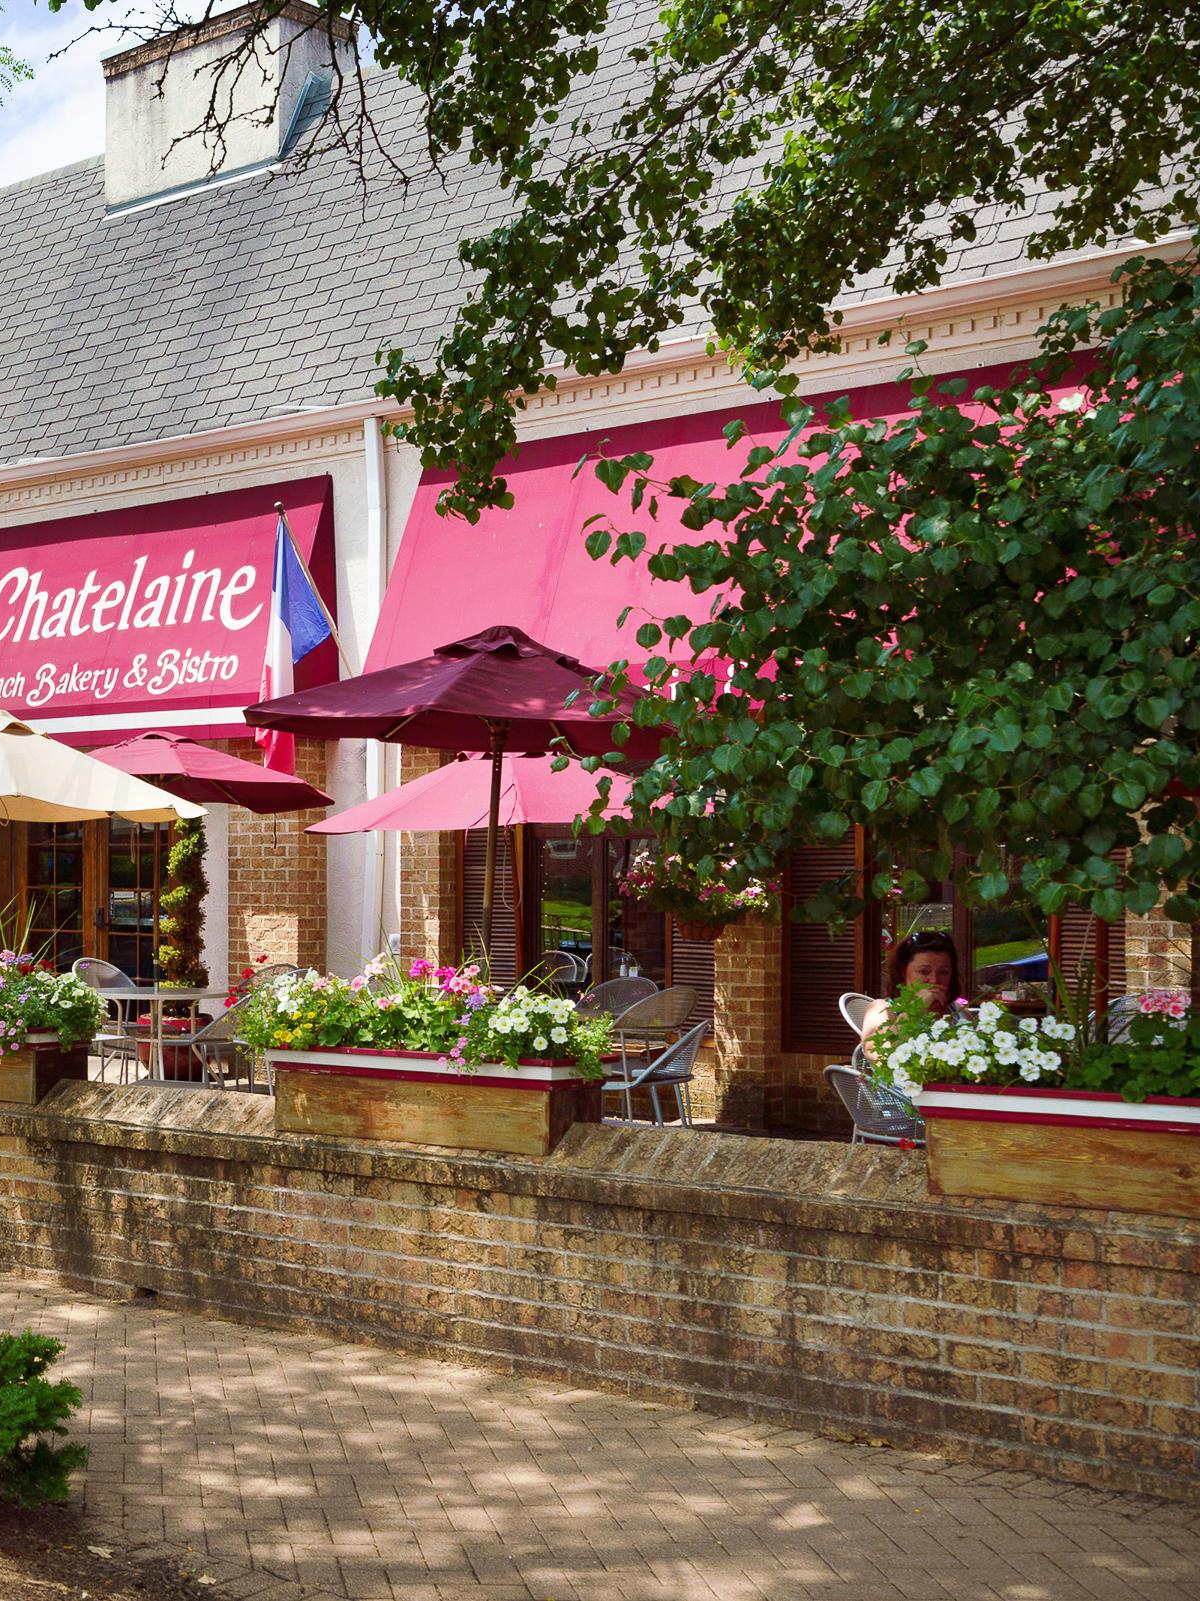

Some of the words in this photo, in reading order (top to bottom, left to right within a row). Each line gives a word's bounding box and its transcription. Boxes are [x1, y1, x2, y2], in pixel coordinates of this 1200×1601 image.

[26, 662, 120, 707] Bakery
[123, 653, 148, 688] &
[147, 647, 239, 695] Bistro
